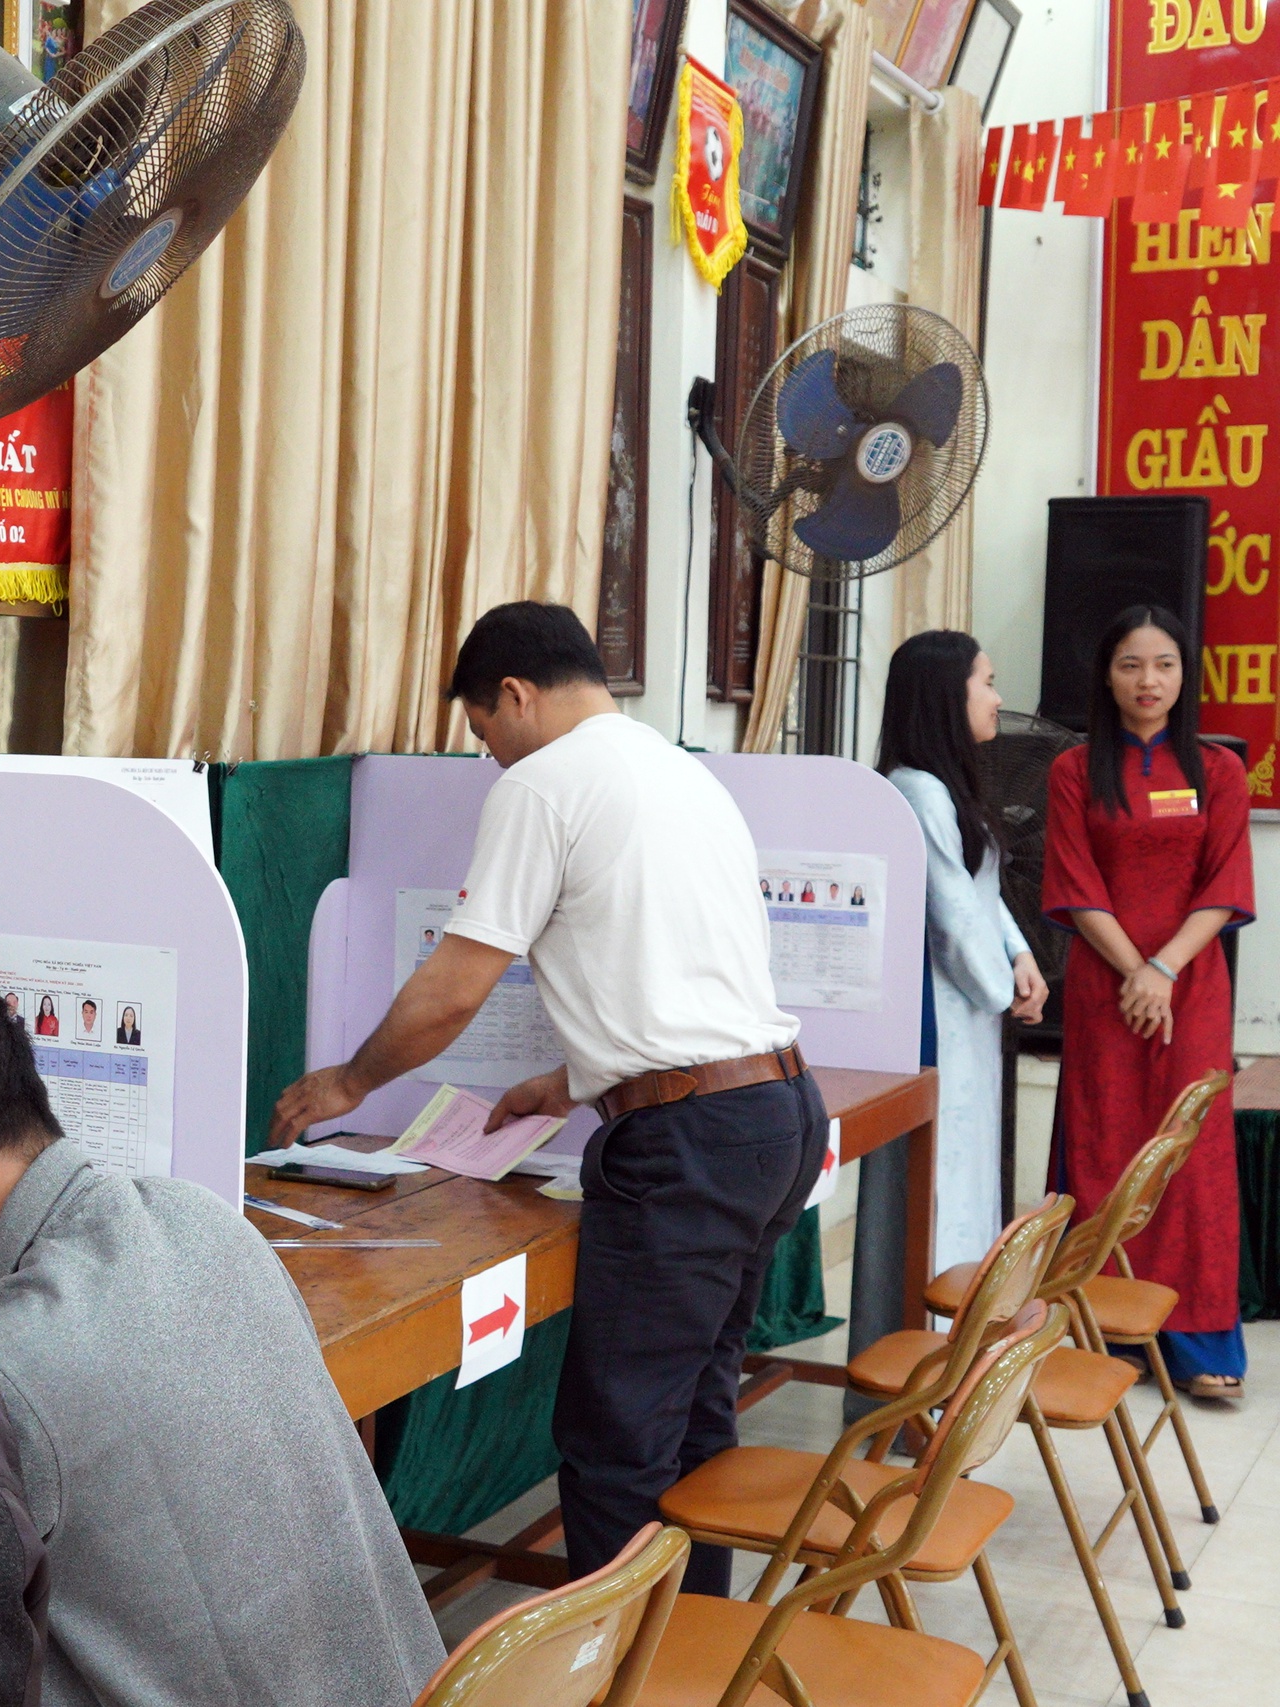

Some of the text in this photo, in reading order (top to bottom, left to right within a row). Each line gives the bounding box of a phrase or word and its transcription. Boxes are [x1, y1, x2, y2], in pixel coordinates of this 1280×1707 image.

[1140, 295, 1267, 381] DÂN
[1126, 393, 1268, 490] GIẦU
[14, 488, 45, 509] CHƯƠNG
[45, 487, 60, 509] MỸ
[9, 525, 26, 543] 02
